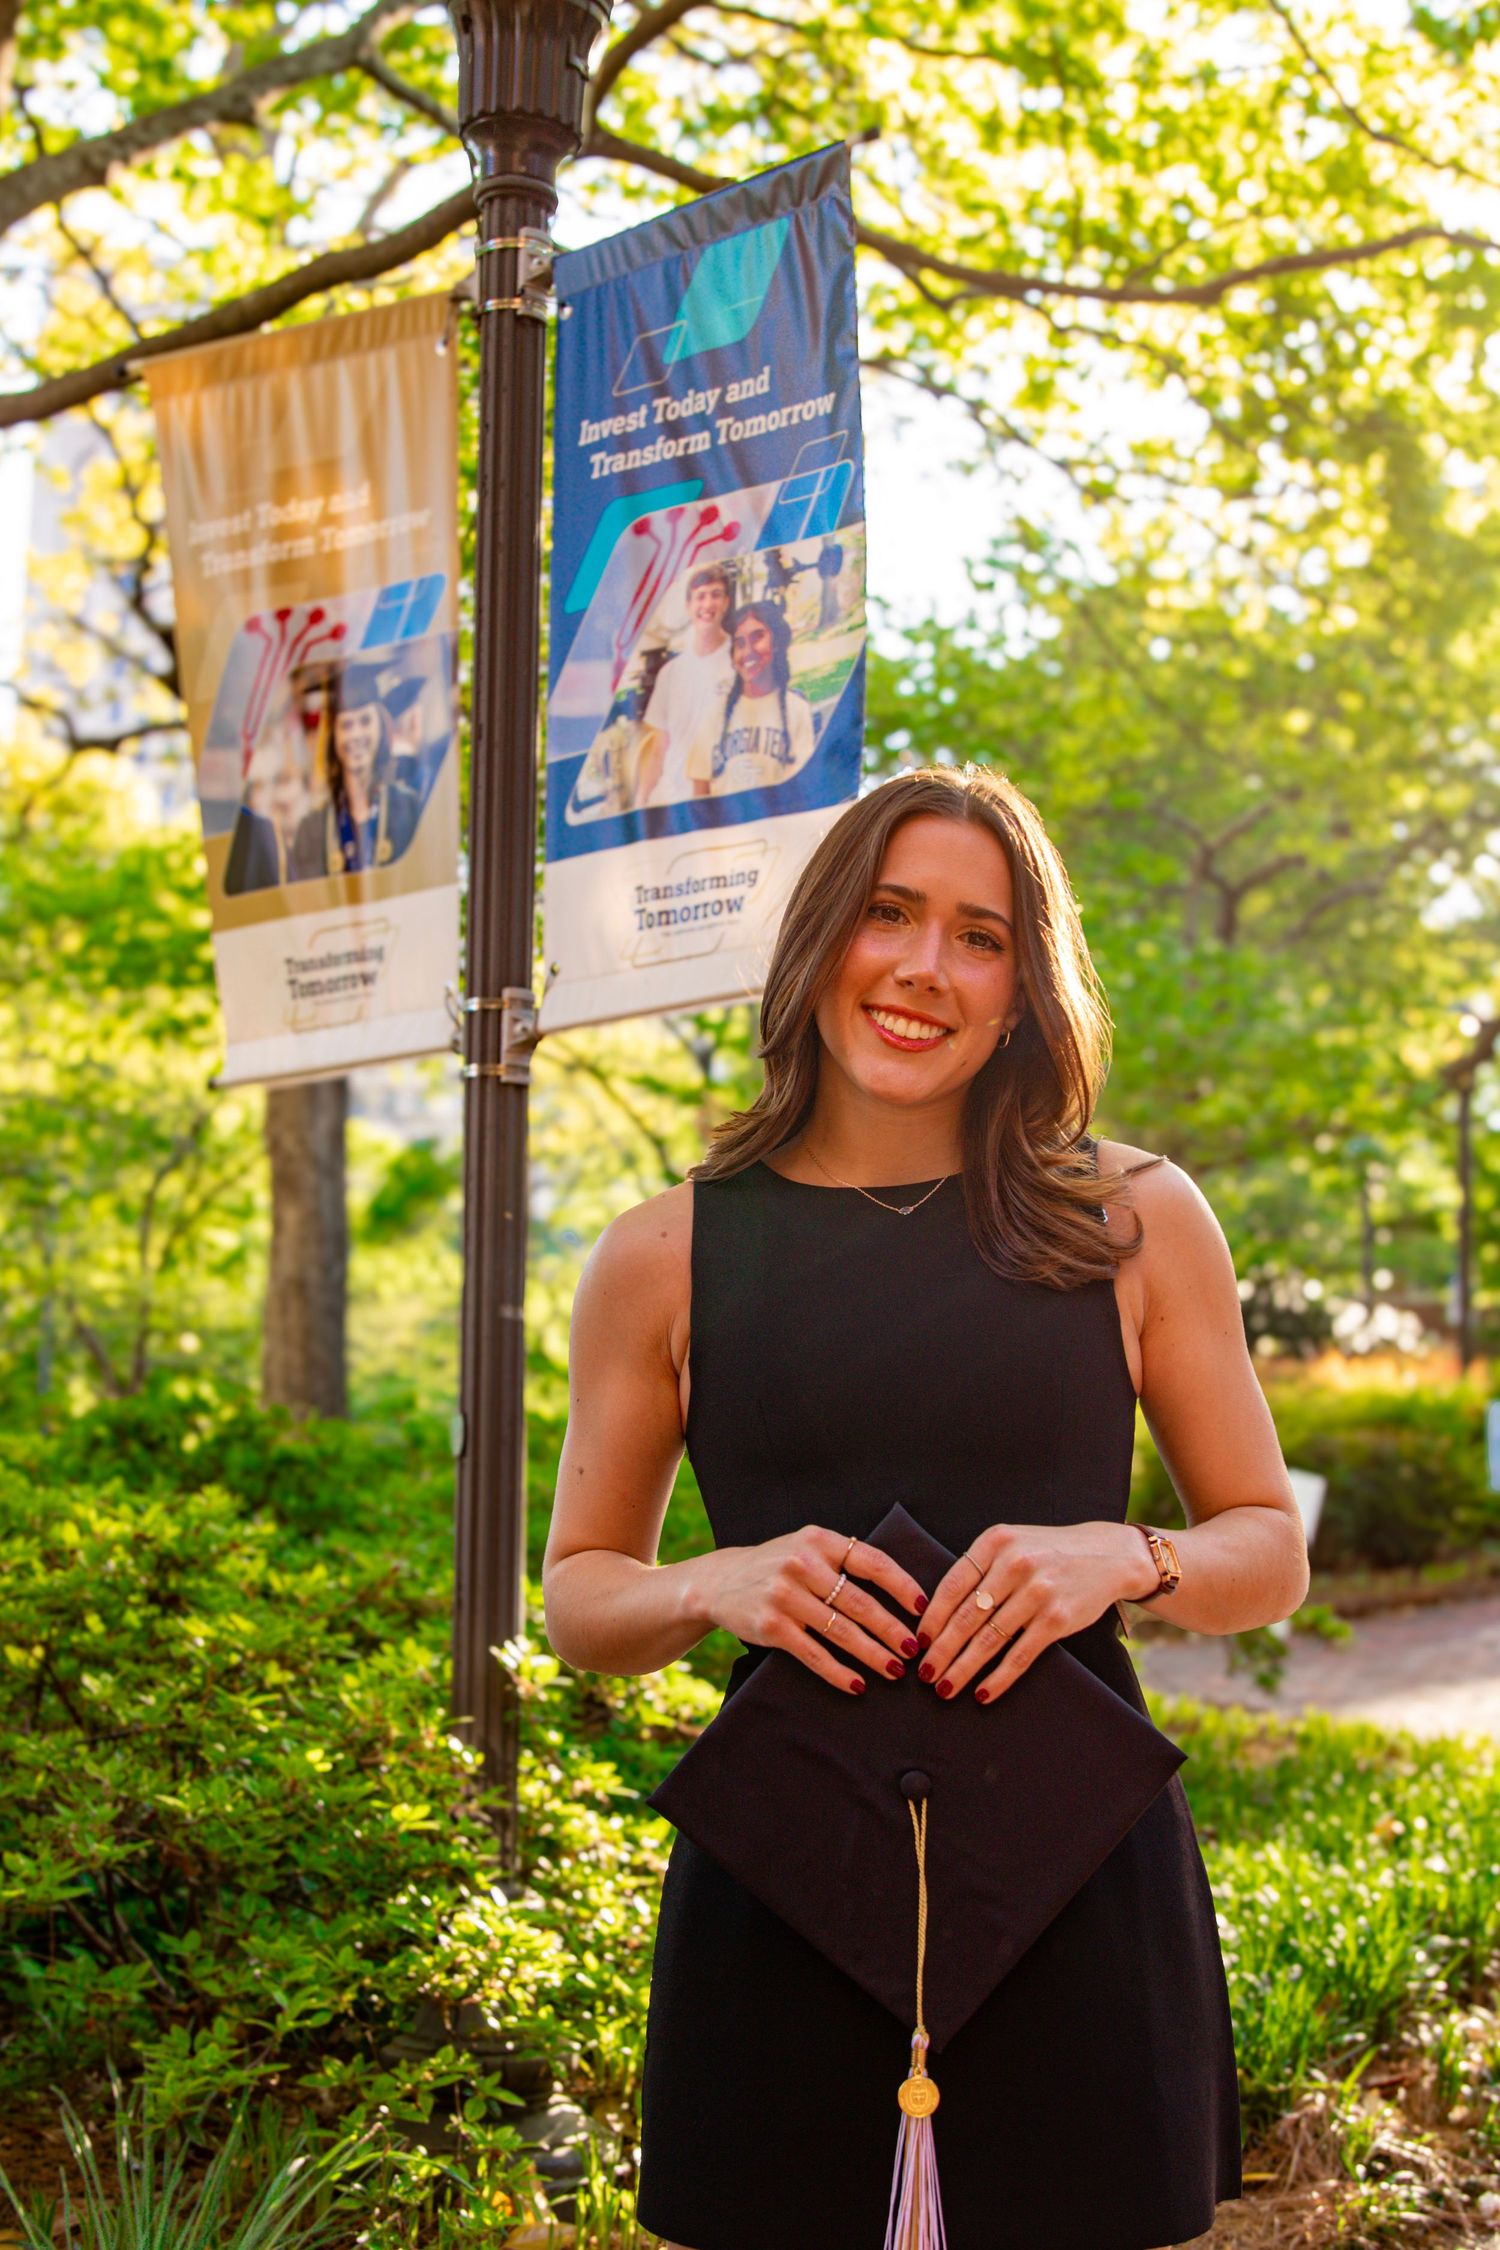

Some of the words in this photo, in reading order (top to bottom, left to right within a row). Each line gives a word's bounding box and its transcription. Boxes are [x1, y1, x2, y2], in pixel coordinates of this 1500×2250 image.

[577, 404, 648, 446] Invest
[653, 389, 720, 424] Today
[725, 365, 770, 404] and
[589, 430, 711, 480] Transform
[715, 392, 836, 446] Tomorrow
[634, 895, 745, 931] Tomorrow
[635, 868, 760, 904] Transforming
